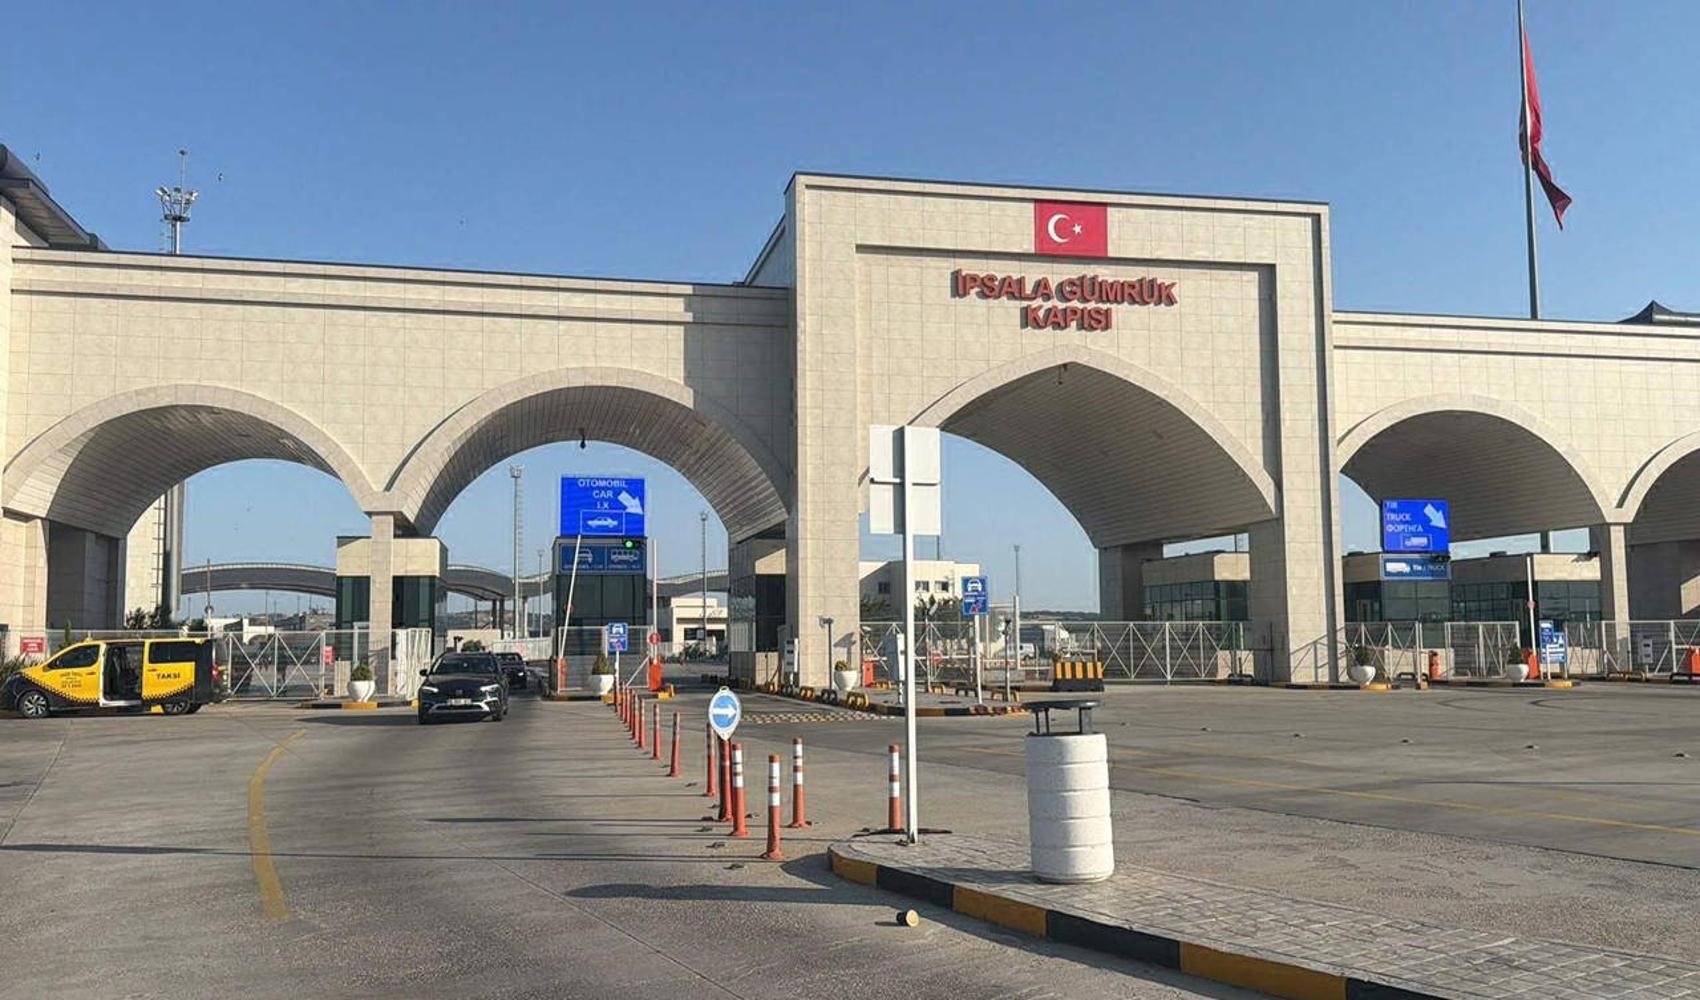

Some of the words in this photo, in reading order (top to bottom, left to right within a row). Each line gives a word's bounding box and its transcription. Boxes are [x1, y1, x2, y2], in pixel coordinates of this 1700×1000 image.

[952, 270, 1054, 301] İPSALA
[1057, 275, 1178, 306] GÜMRÜK
[1021, 304, 1113, 331] KAPISI
[593, 490, 613, 499] CAR
[1386, 513, 1411, 521] TRUCK
